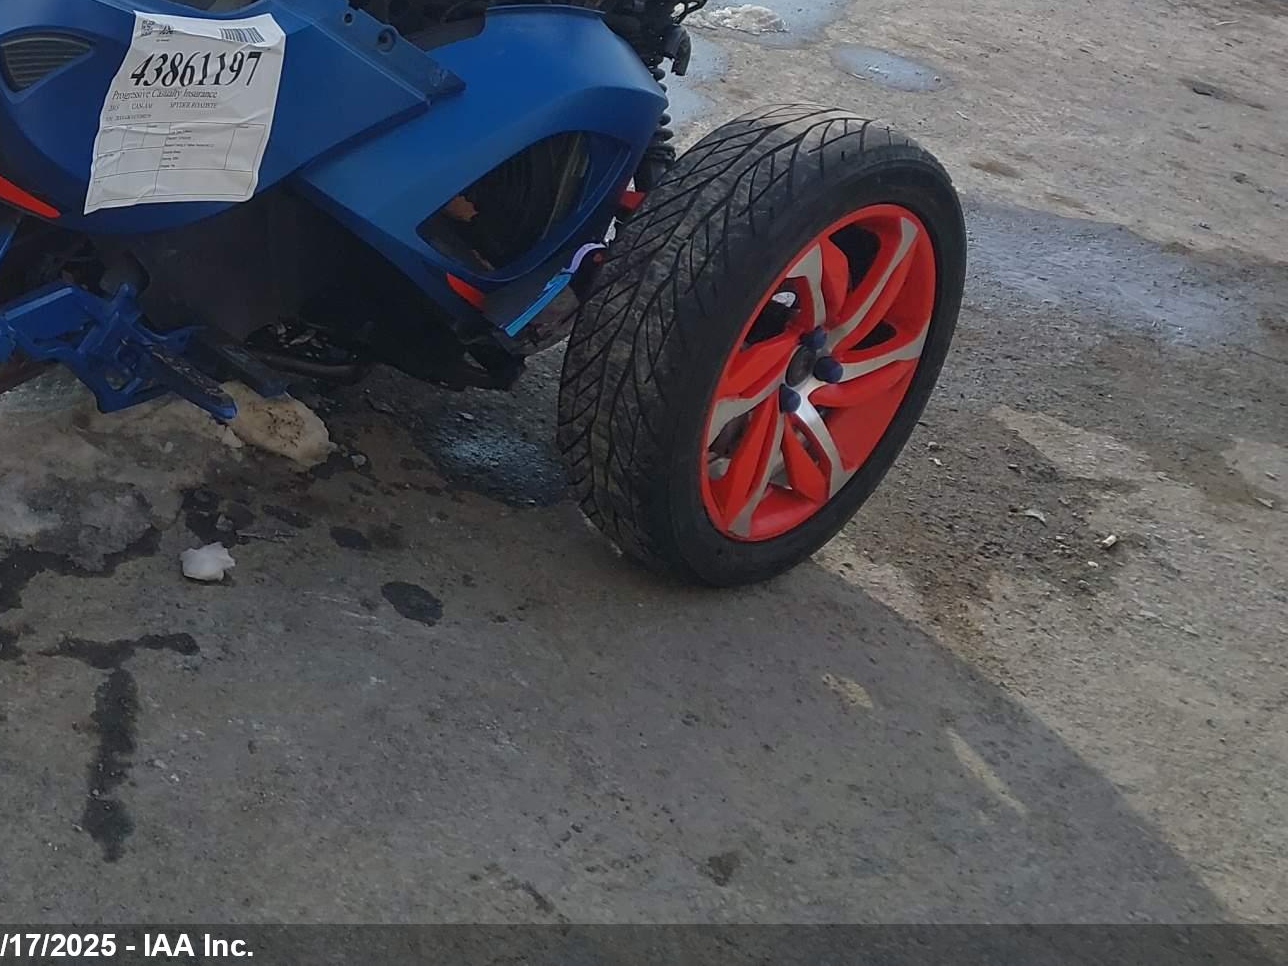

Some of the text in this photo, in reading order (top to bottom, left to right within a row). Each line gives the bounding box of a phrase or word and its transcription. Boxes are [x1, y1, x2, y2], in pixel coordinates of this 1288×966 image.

[130, 51, 263, 87] 43861197
[112, 90, 151, 102] Progressive
[183, 88, 218, 99] Insurance
